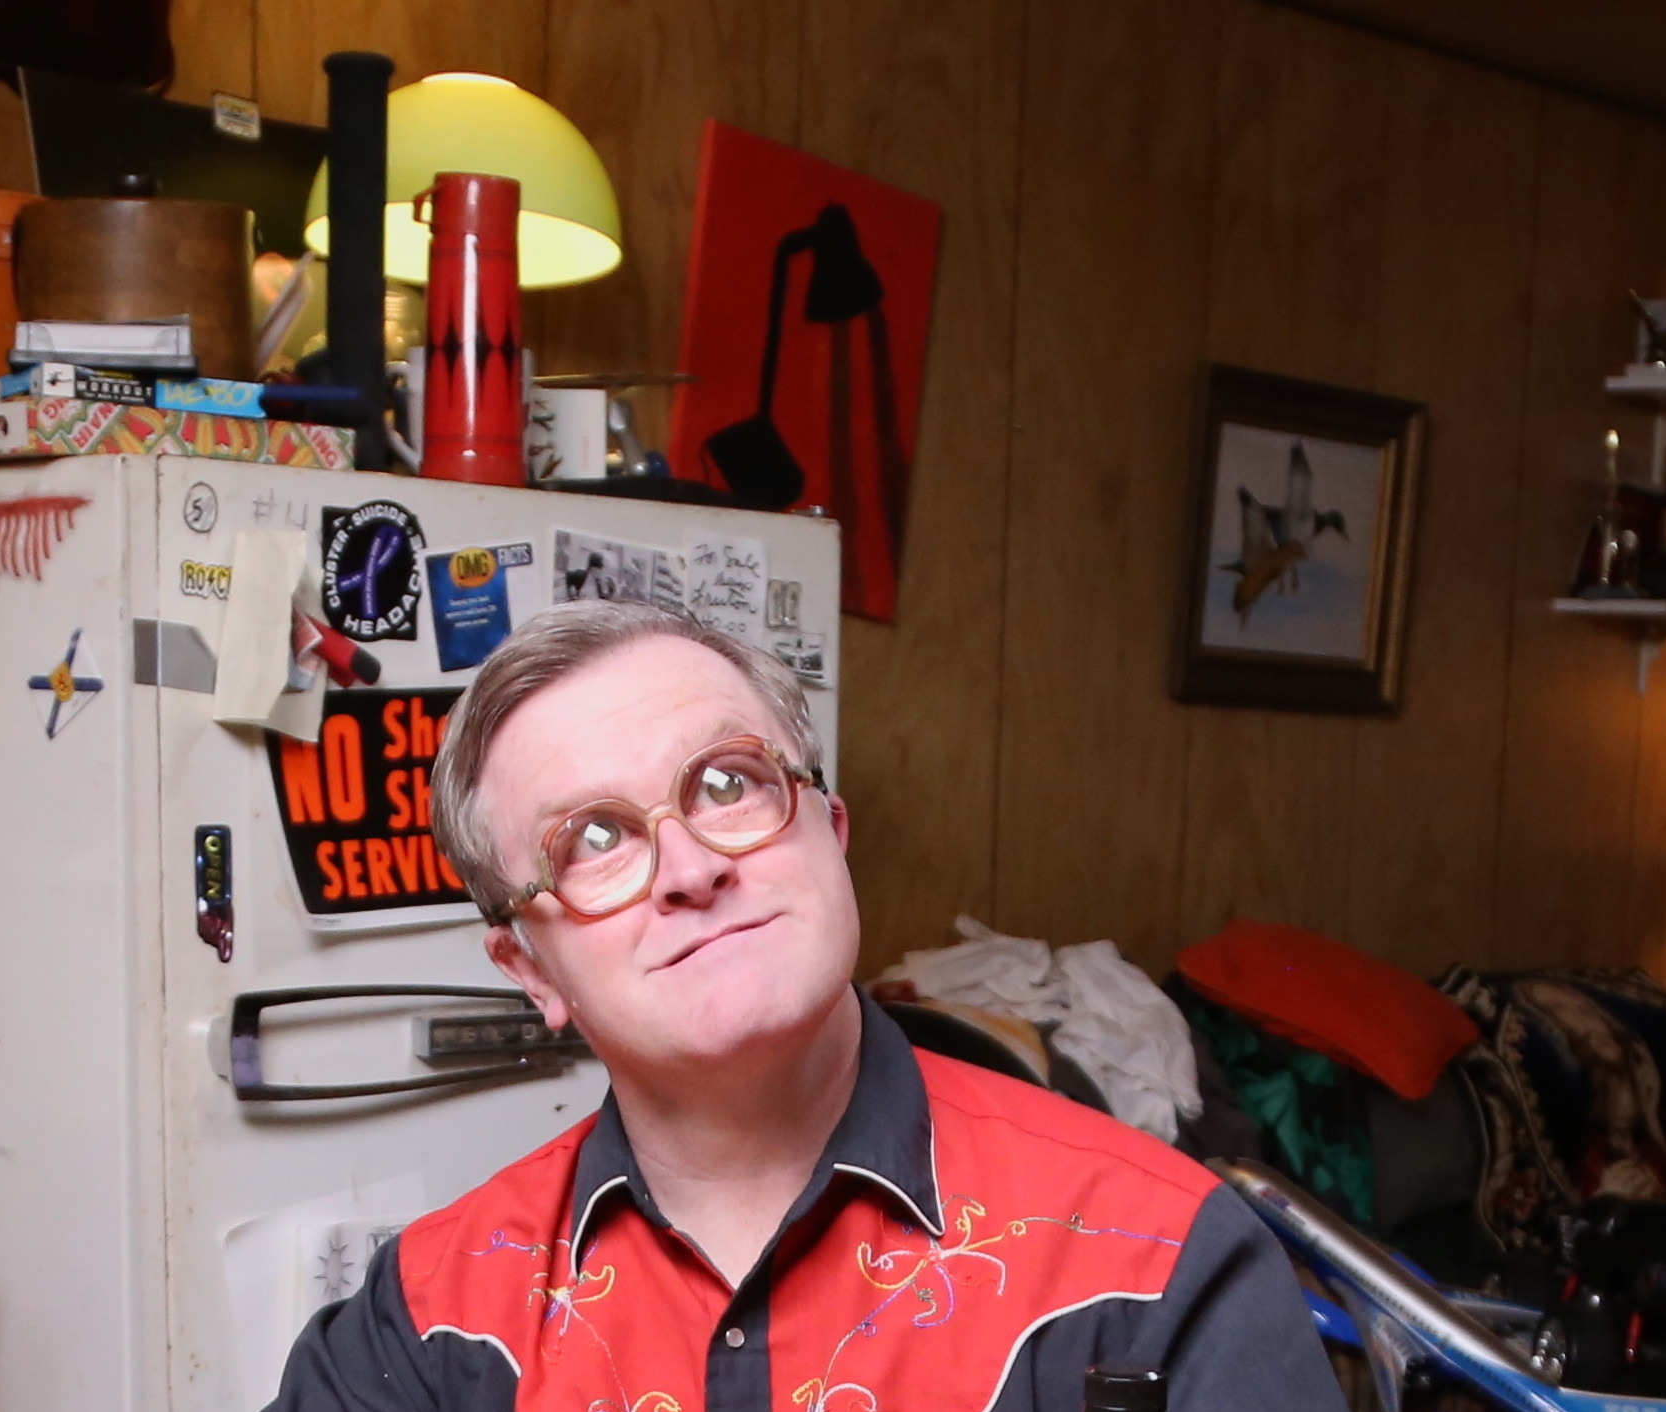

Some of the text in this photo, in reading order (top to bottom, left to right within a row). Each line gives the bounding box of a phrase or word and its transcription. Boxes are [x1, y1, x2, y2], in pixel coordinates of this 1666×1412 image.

[351, 504, 408, 527] SUICIDE
[325, 529, 348, 608] CLUSTER
[456, 551, 488, 580] OMG
[279, 713, 366, 825] NO
[205, 834, 222, 900] OPEN
